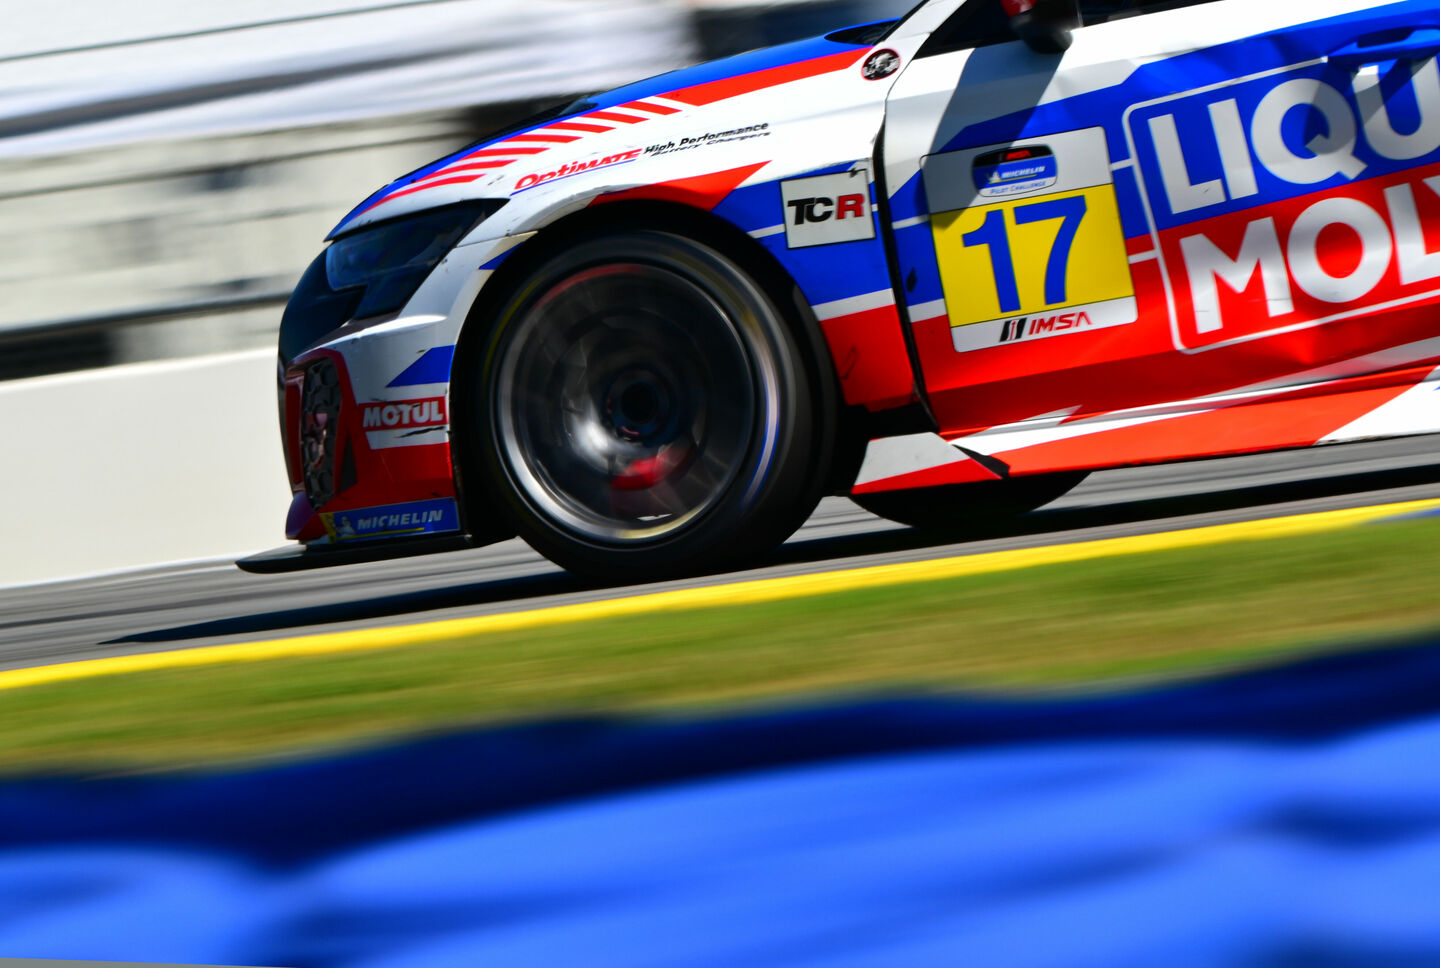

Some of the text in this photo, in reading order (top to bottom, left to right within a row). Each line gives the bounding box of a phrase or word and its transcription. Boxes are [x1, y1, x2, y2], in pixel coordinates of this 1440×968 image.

[644, 122, 769, 157] High Performance
[786, 192, 866, 226] TCR
[962, 194, 1089, 314] 17
[1029, 310, 1092, 336] IMSA
[362, 400, 444, 428] MOTUL
[357, 509, 444, 530] MICHELIN
